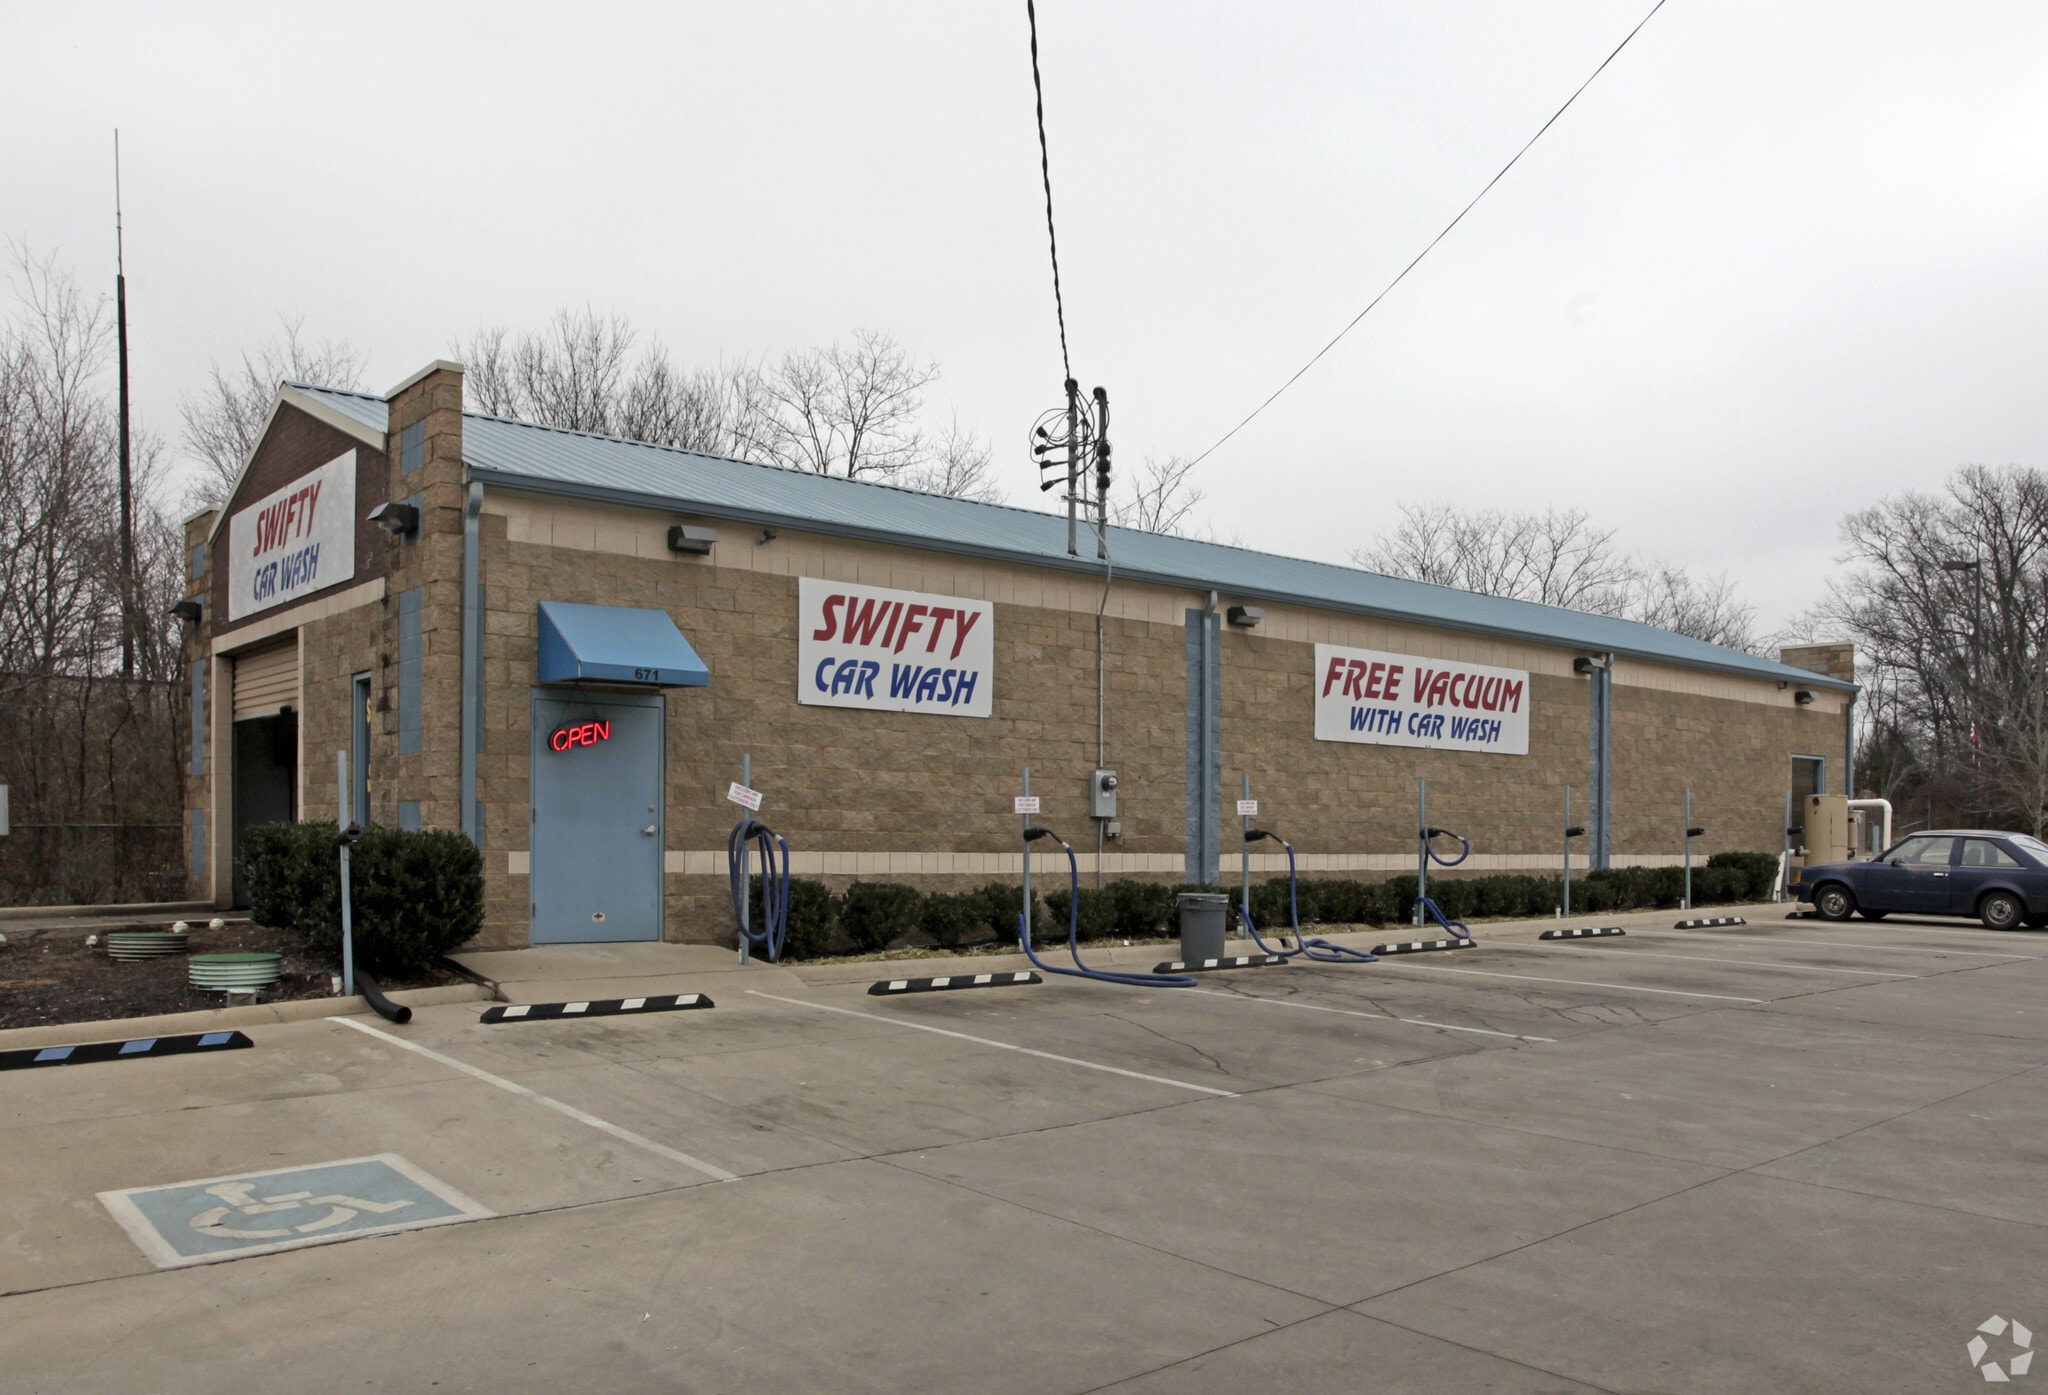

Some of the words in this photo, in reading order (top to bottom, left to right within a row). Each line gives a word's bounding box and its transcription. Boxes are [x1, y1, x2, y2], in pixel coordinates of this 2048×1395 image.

[253, 479, 322, 558] SWIFTY
[253, 561, 278, 602] CAR
[281, 542, 320, 591] WASH
[813, 594, 982, 661] SWIFTY
[635, 668, 659, 680] 671
[815, 657, 880, 700] CAR
[890, 663, 978, 708] WASH
[1322, 657, 1404, 701] FREE
[1413, 667, 1523, 713] VACUUM
[552, 720, 610, 751] OPEN
[1350, 706, 1402, 736] WITH
[1408, 712, 1445, 740] CAR
[1451, 716, 1501, 744] WASH
